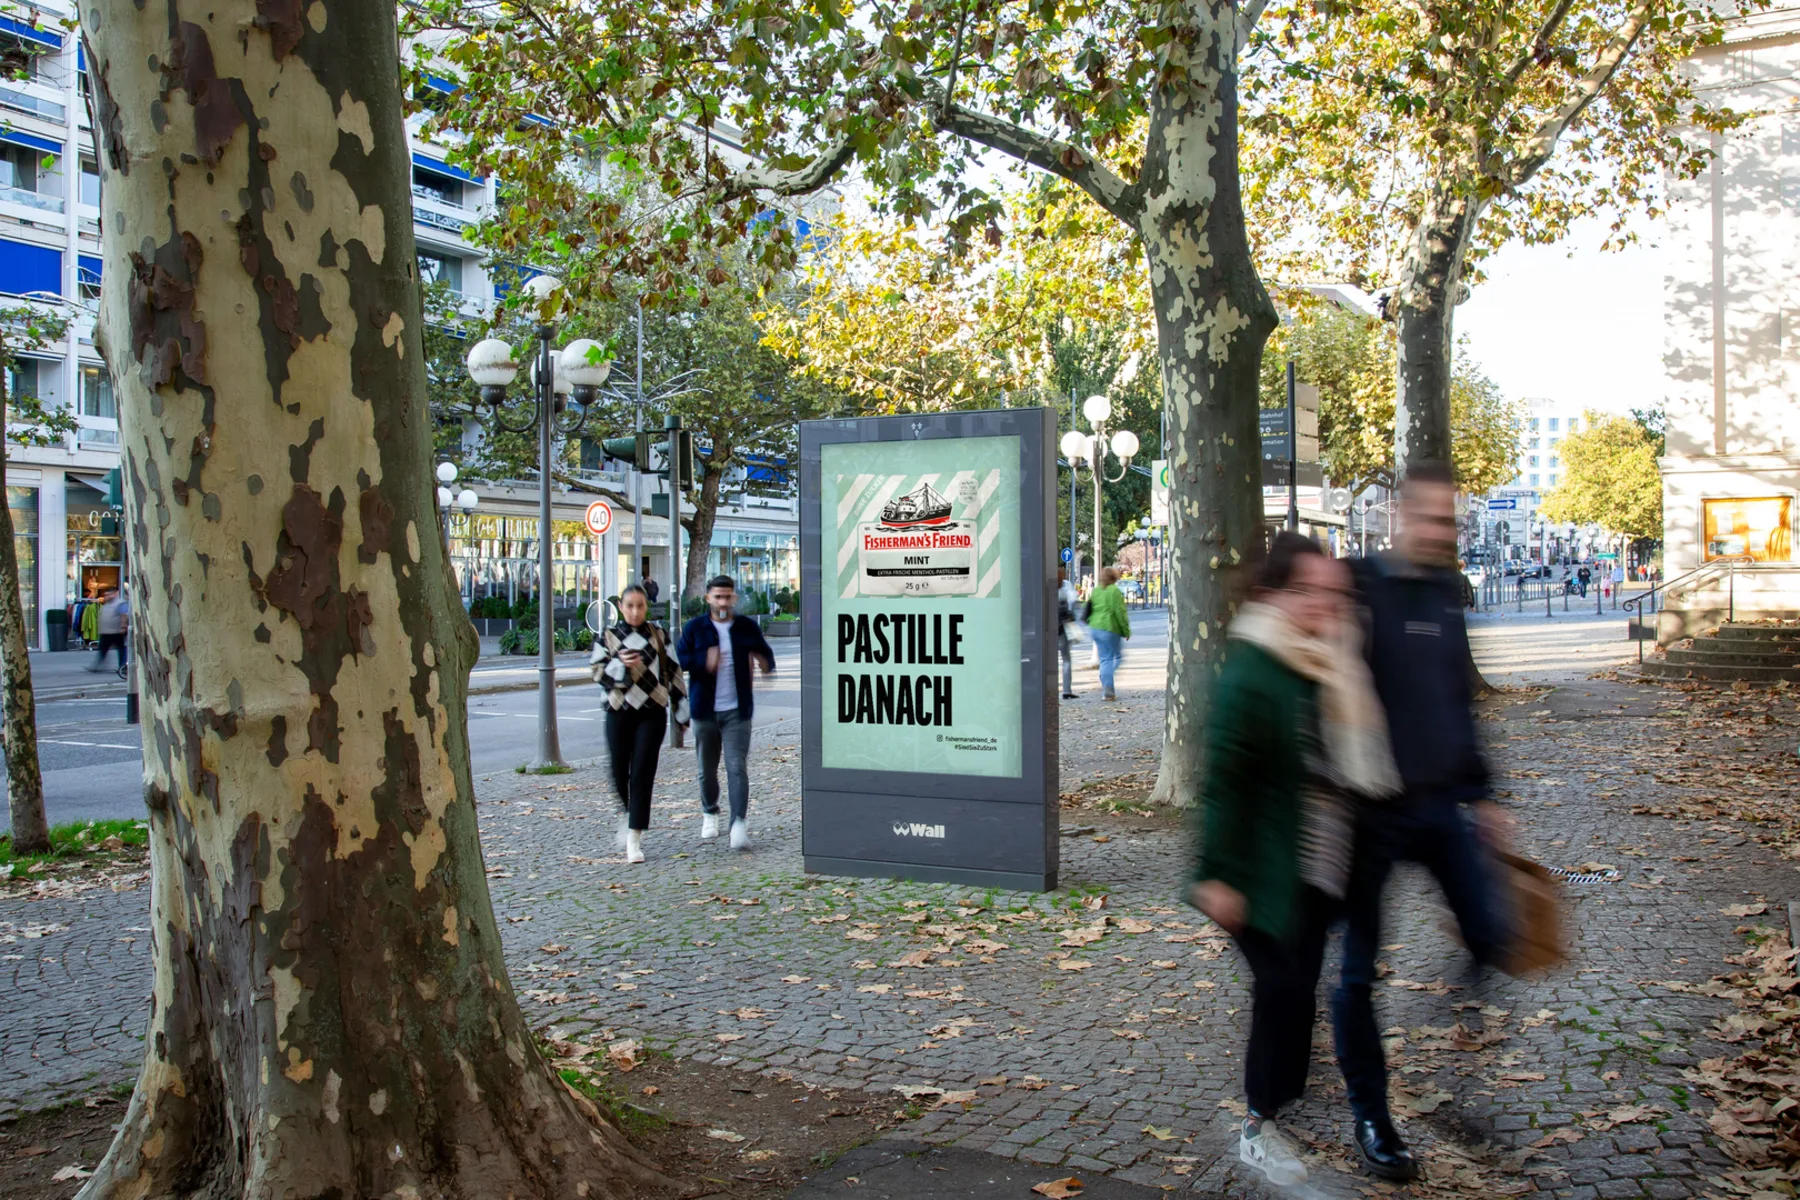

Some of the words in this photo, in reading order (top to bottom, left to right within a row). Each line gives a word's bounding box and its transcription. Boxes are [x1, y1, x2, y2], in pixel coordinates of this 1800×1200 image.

[592, 511, 607, 525] 40
[864, 533, 931, 550] FISHERMAN'S
[932, 532, 971, 549] FRIEND
[904, 556, 930, 565] MINT
[838, 614, 964, 664] PASTILLE
[838, 674, 952, 726] DANACH
[945, 735, 998, 744] fishermansfriend_de
[954, 744, 998, 752] #SindSieZuStark
[909, 823, 945, 838] Wall
